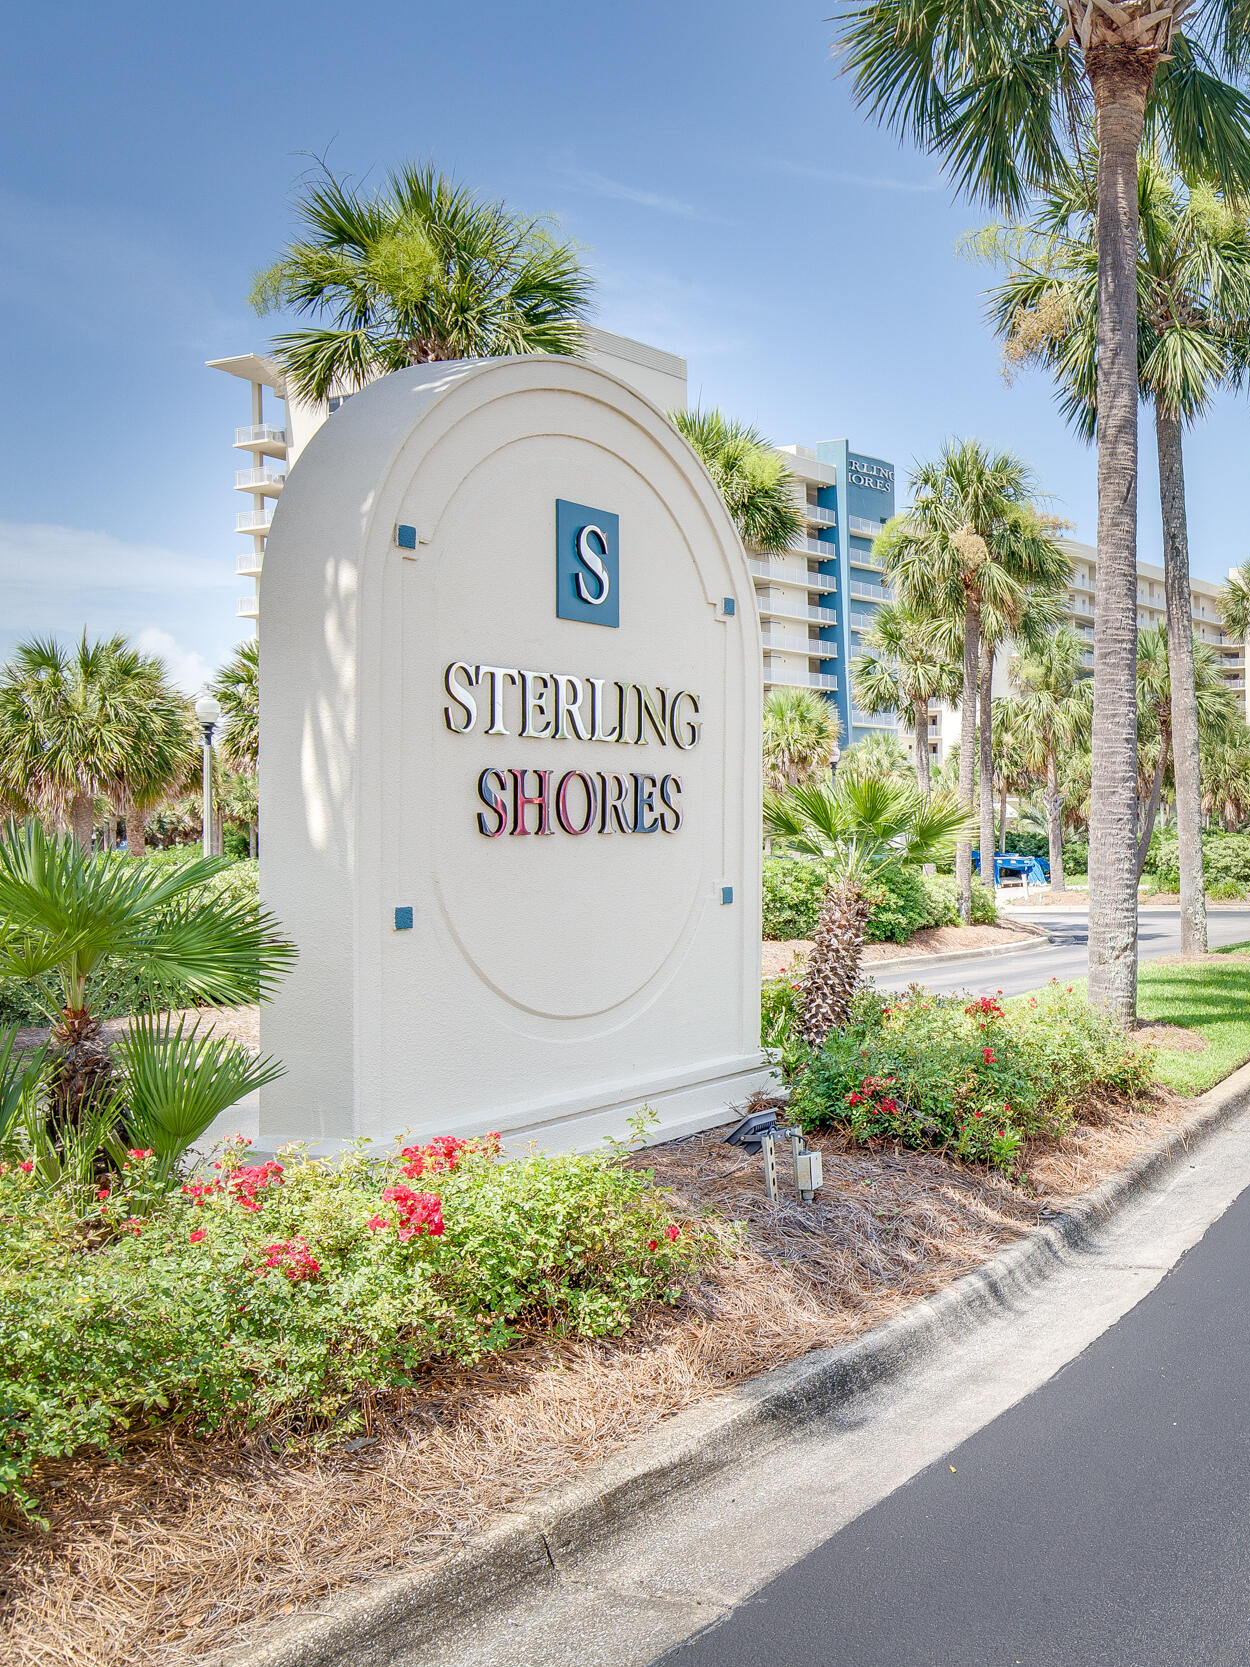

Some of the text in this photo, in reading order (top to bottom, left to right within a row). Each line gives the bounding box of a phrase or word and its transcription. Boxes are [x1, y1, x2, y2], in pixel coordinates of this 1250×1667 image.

[574, 524, 610, 605] S
[444, 661, 703, 750] STERLING
[477, 767, 684, 837] SHORES
